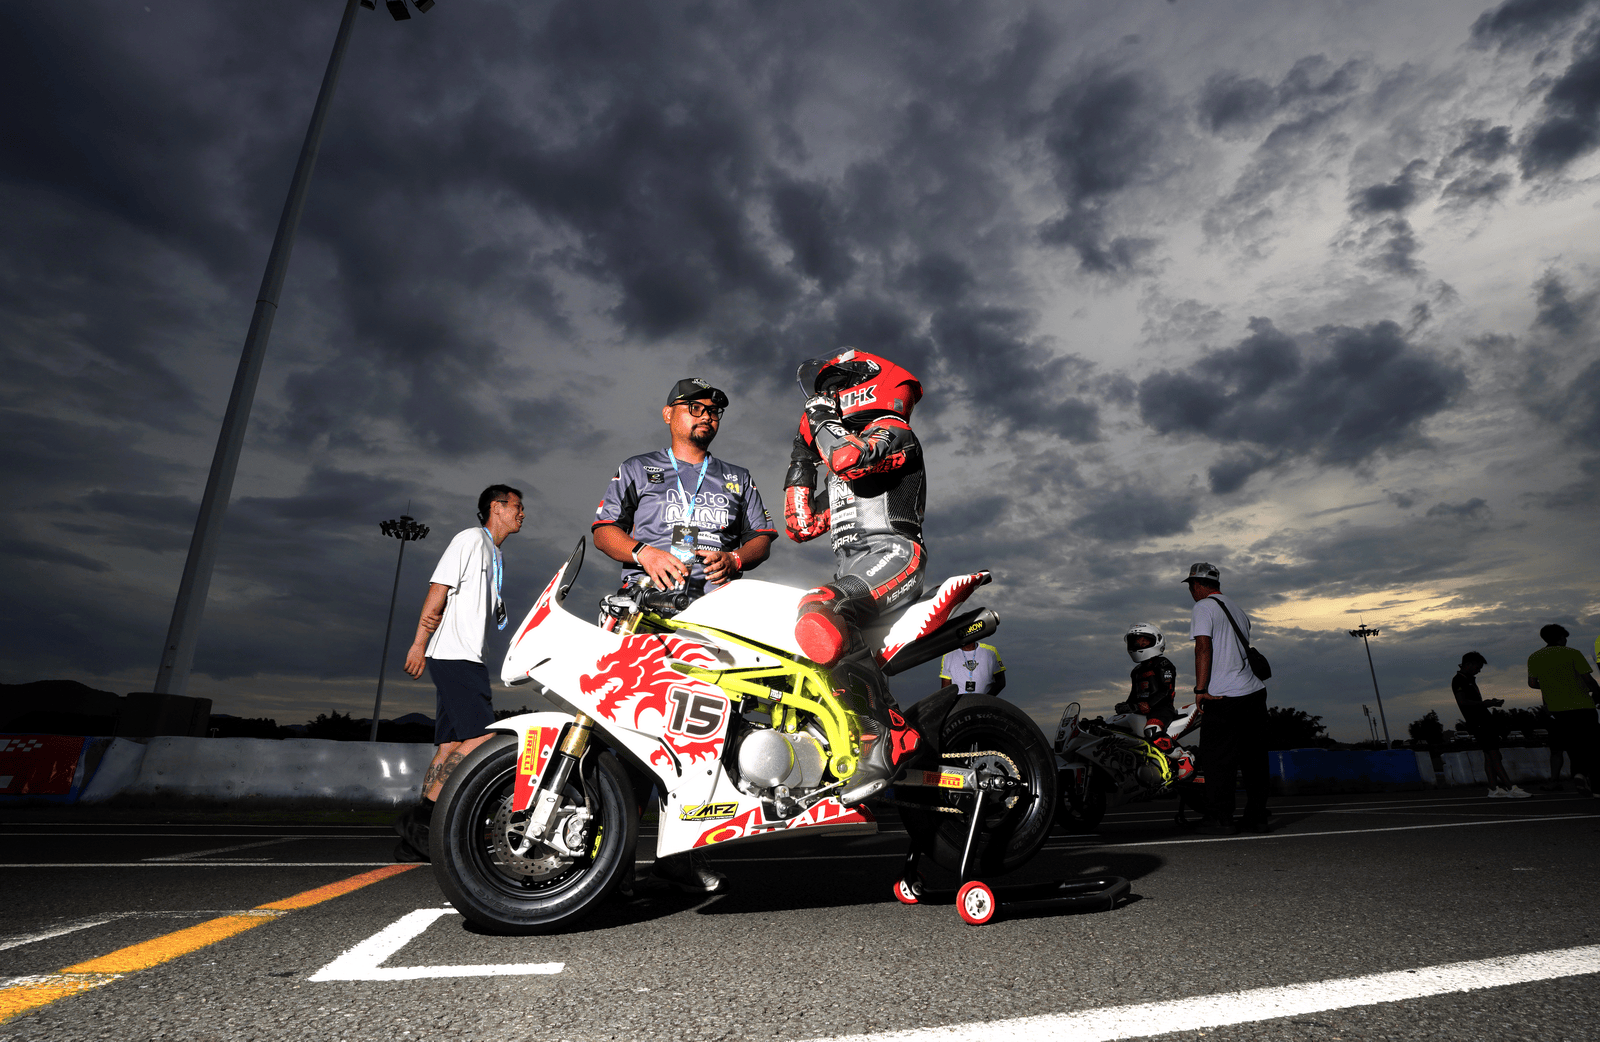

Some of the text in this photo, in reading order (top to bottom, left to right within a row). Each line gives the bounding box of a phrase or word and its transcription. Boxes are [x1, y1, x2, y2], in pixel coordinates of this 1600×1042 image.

[672, 690, 724, 735] 15
[523, 729, 538, 772] PIRELLI
[696, 803, 736, 817] MFZ
